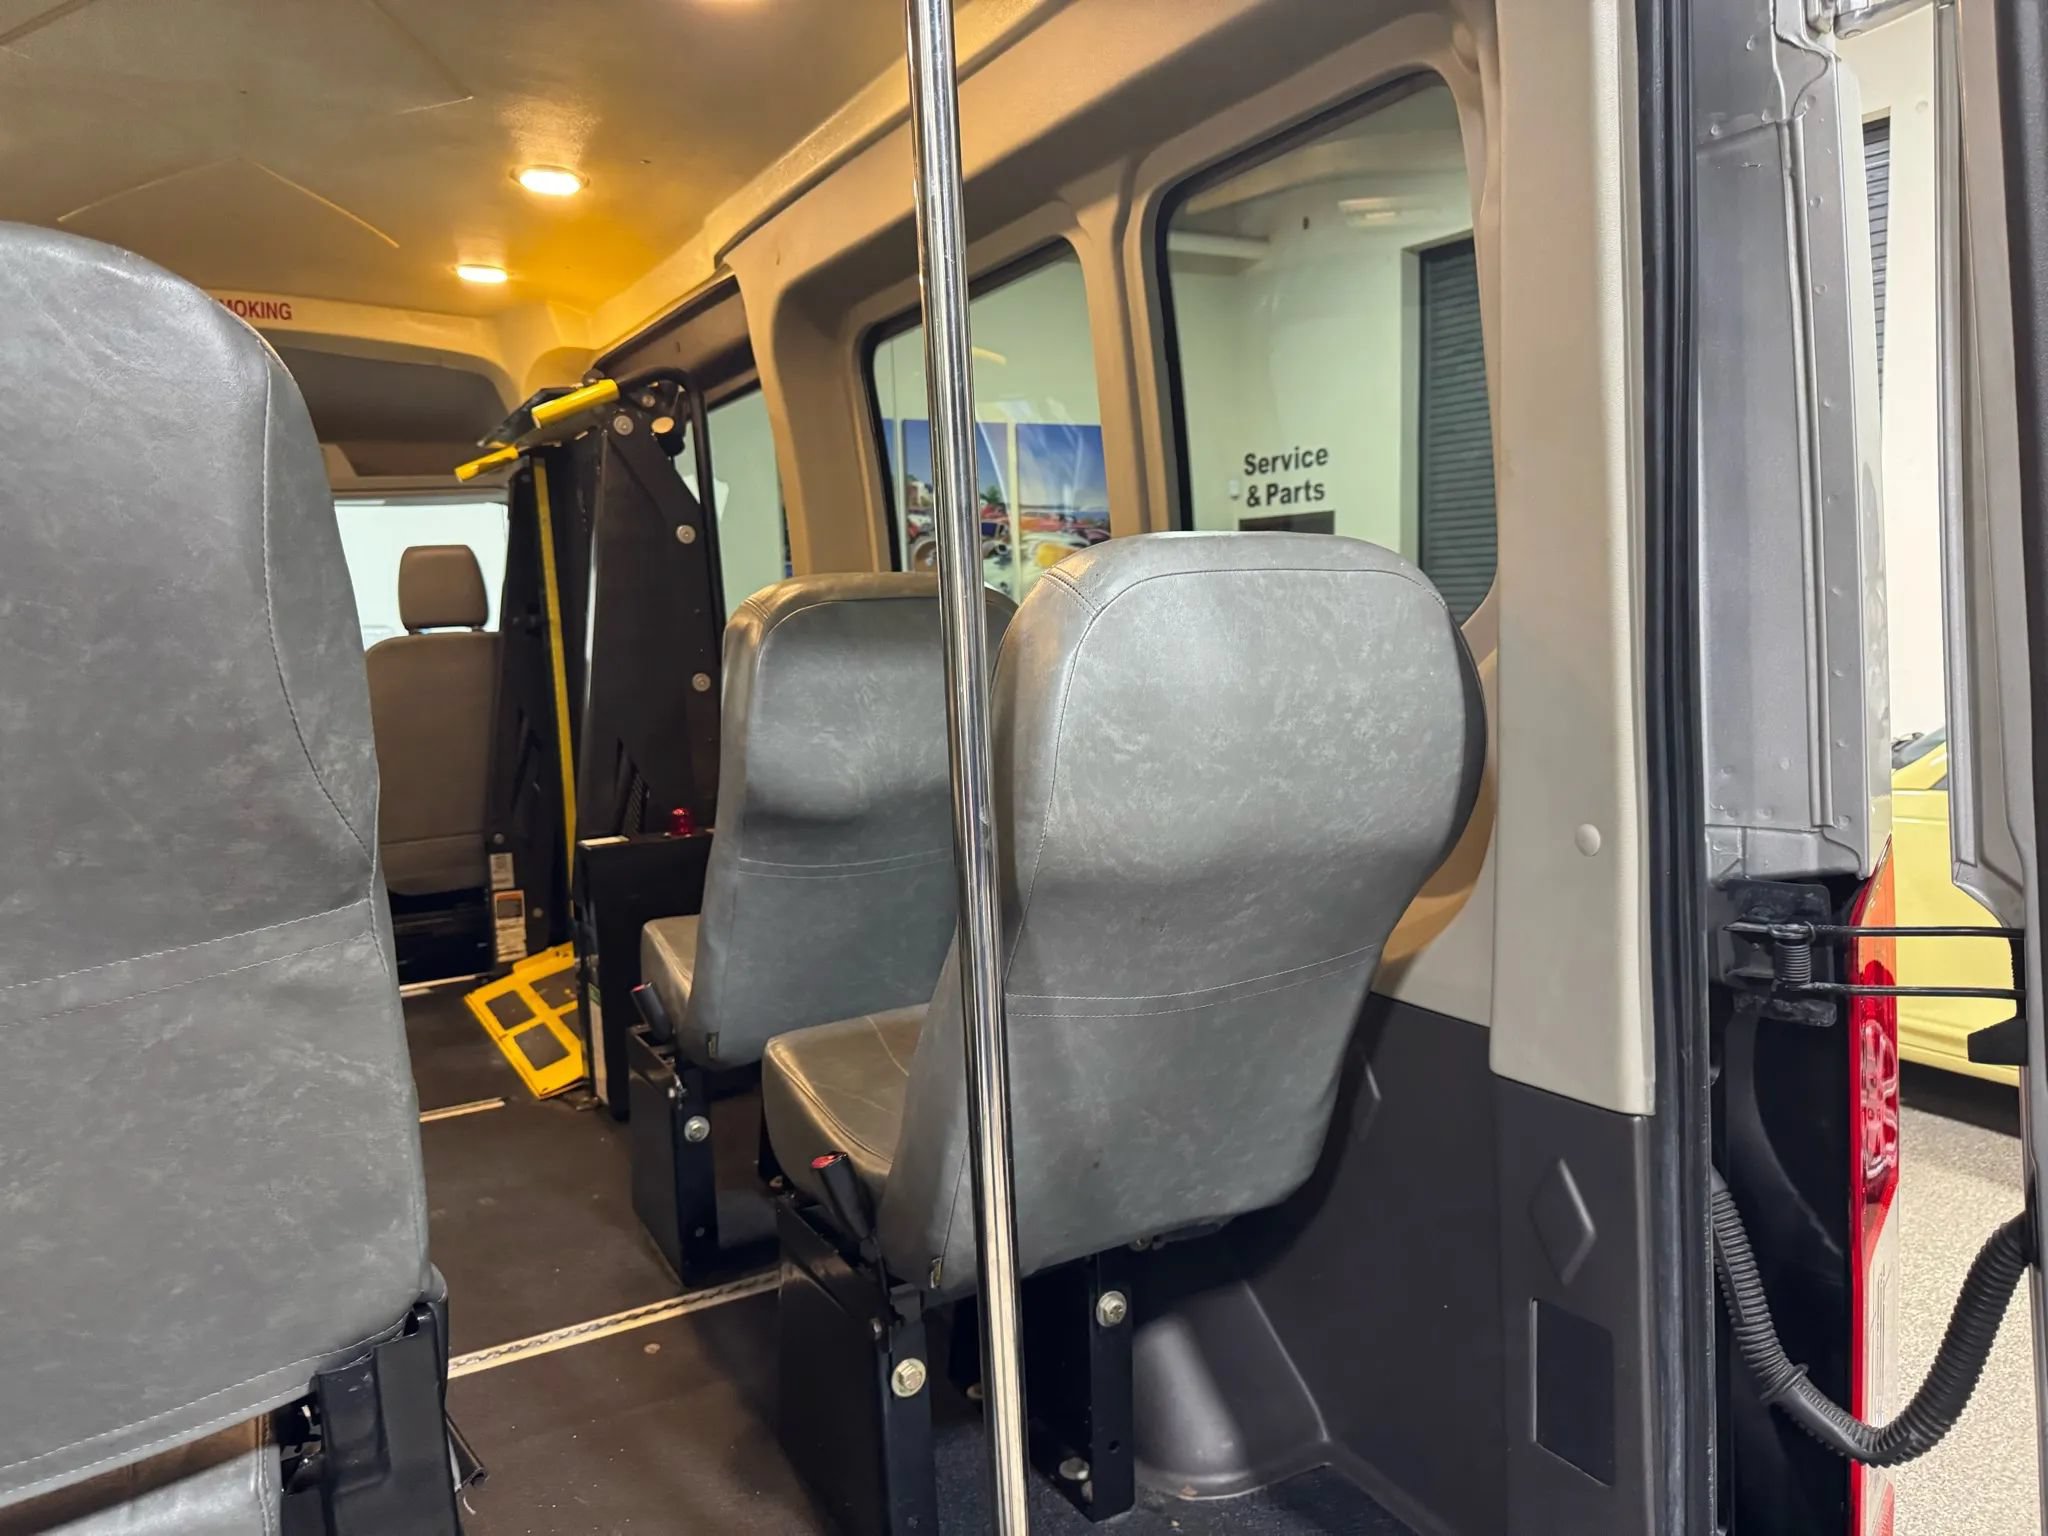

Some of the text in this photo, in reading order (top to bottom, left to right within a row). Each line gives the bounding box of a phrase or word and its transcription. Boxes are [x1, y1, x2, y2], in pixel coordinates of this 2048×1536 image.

[1244, 446, 1328, 476] Service
[1246, 480, 1325, 508] & Parts
